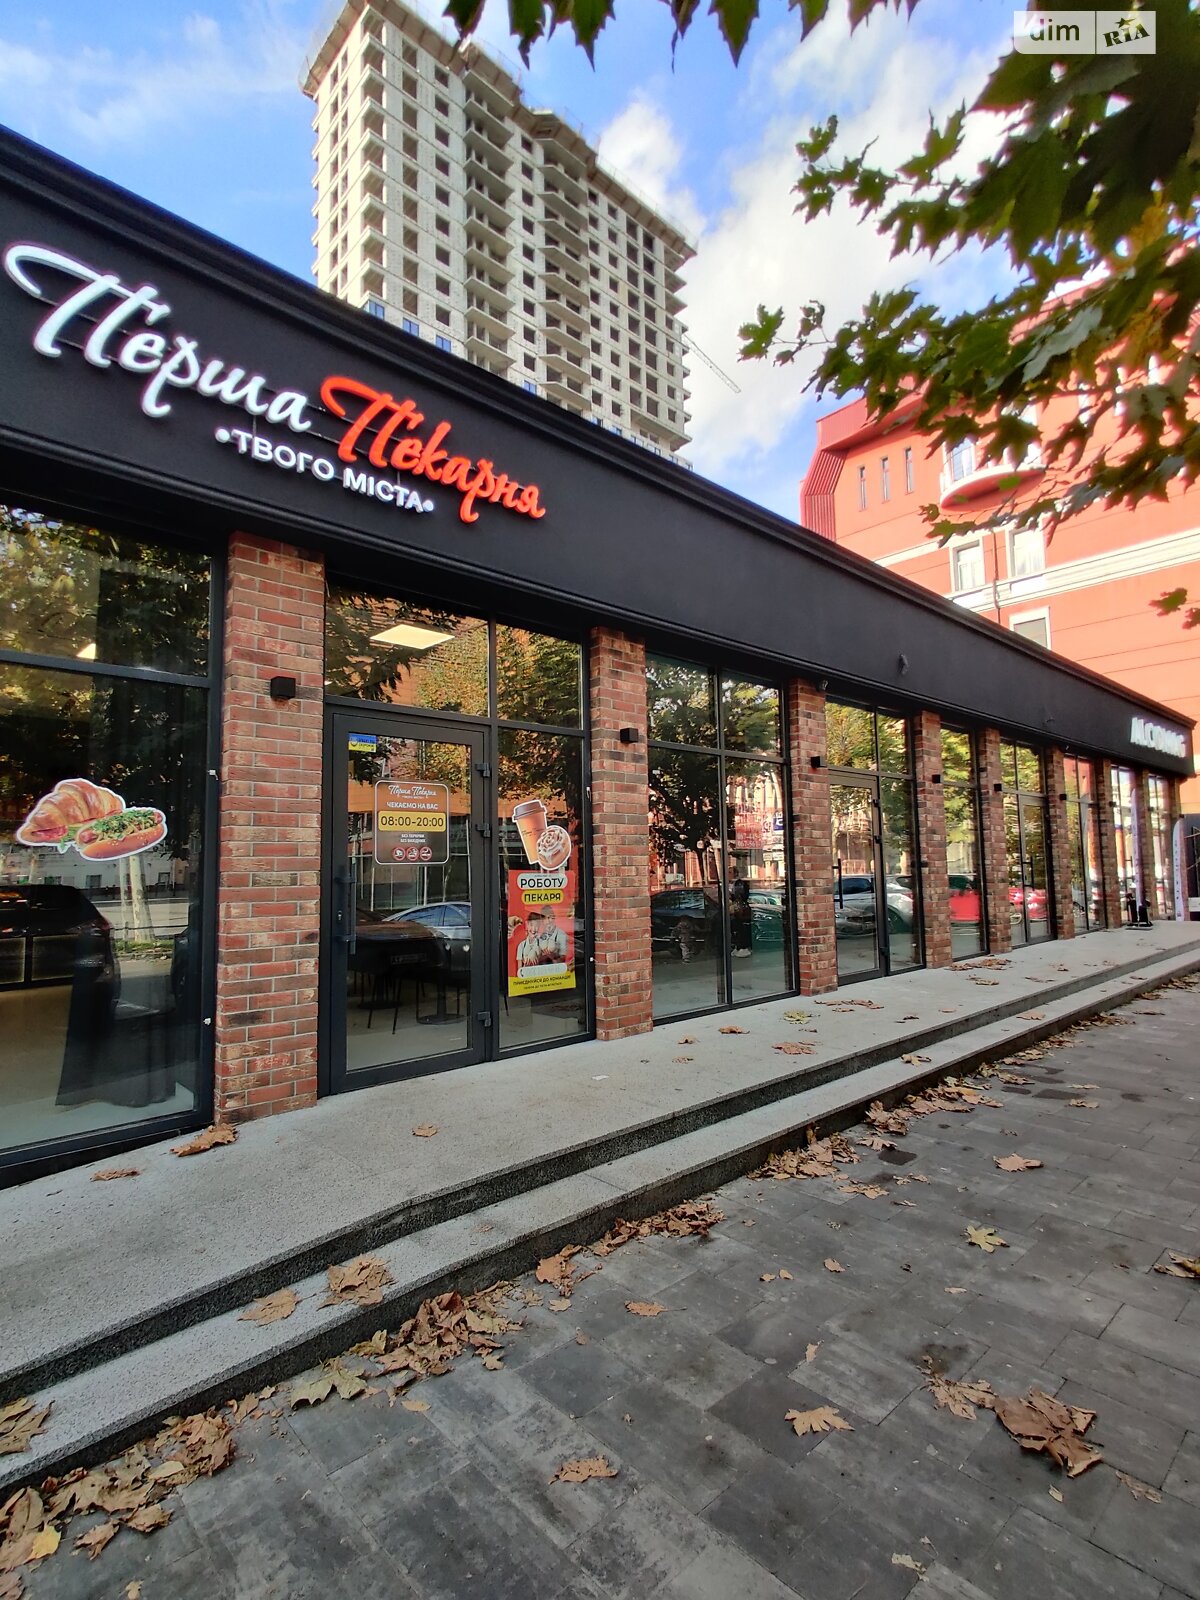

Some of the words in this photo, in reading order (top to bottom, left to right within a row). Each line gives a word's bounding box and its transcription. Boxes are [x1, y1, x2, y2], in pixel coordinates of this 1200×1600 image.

[4, 242, 312, 431] Перша
[320, 375, 547, 523] Пекарня
[387, 801, 417, 809] ЧЕКАЄМО
[381, 816, 444, 827] 08:00-20:00
[520, 877, 564, 888] РОБОТУ
[524, 892, 561, 903] ПЕКАРЯ
